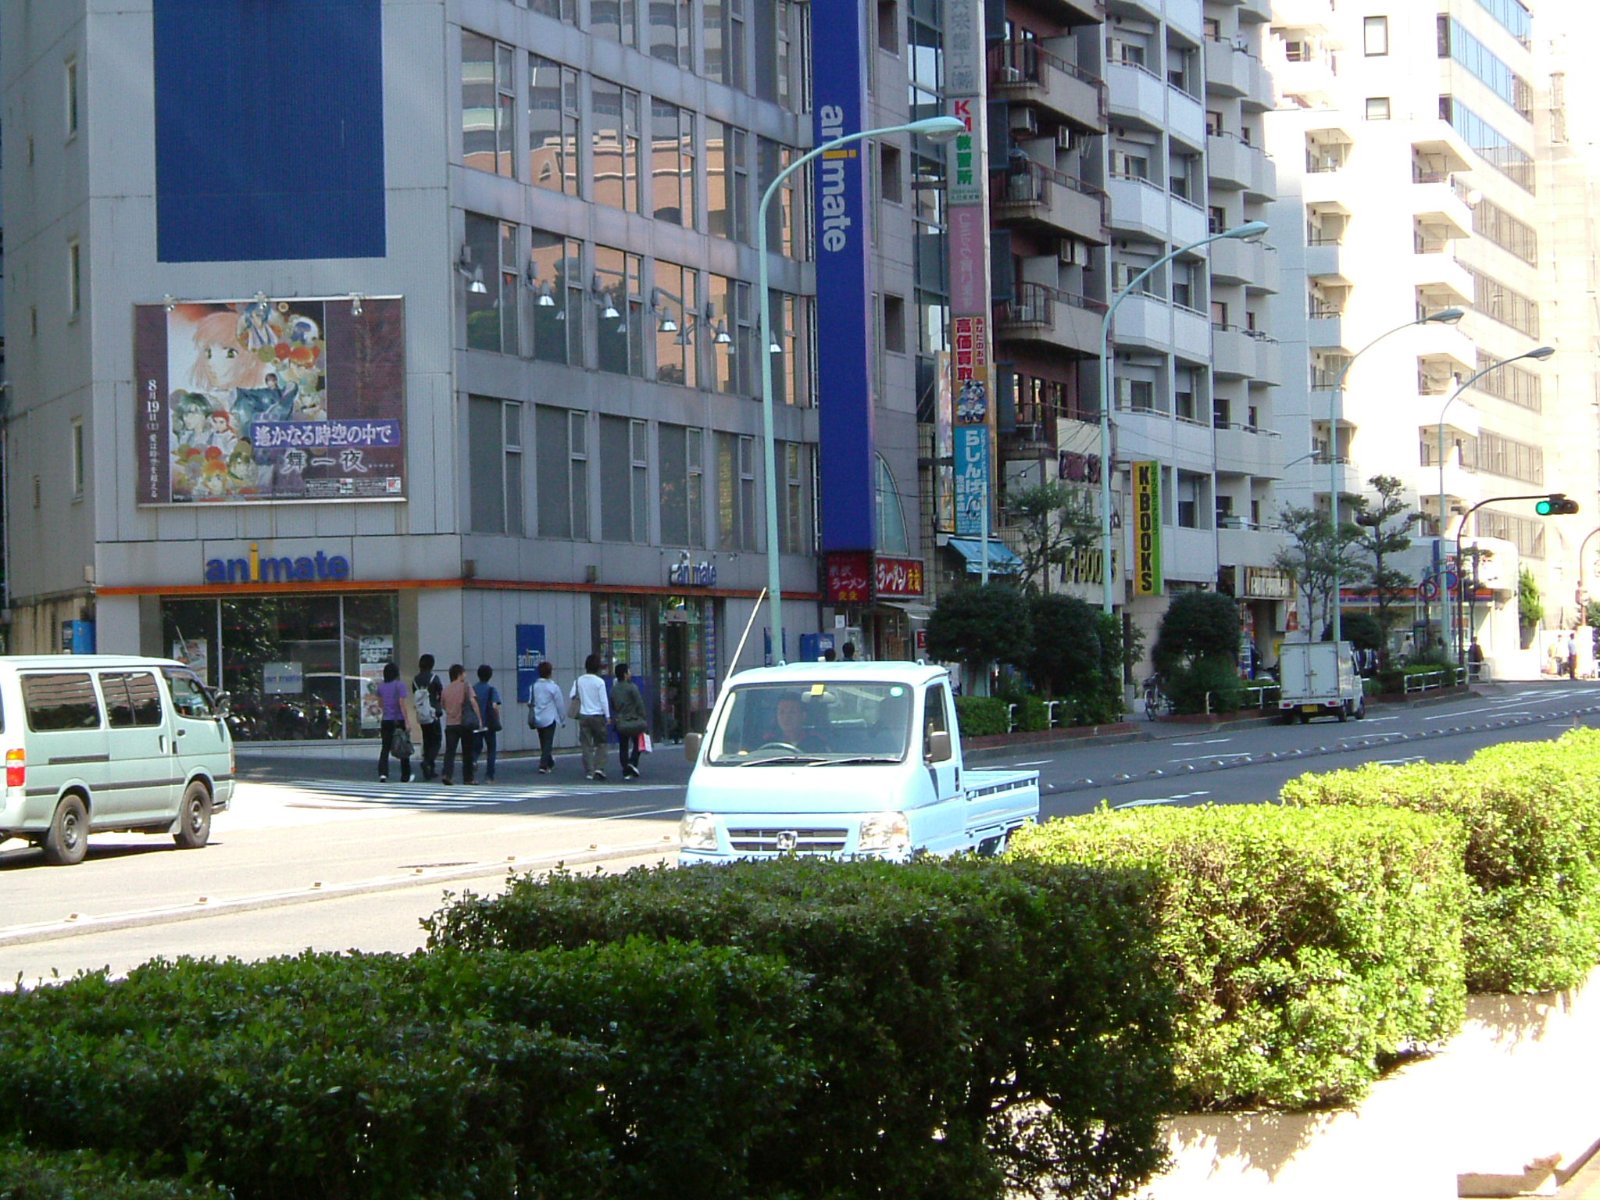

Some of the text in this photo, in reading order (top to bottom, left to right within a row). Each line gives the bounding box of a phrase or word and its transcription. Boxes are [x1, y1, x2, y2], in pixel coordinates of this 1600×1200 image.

[820, 105, 857, 252] animate
[205, 543, 350, 582] animate
[669, 561, 717, 586] animate
[832, 577, 866, 589] ラーメン
